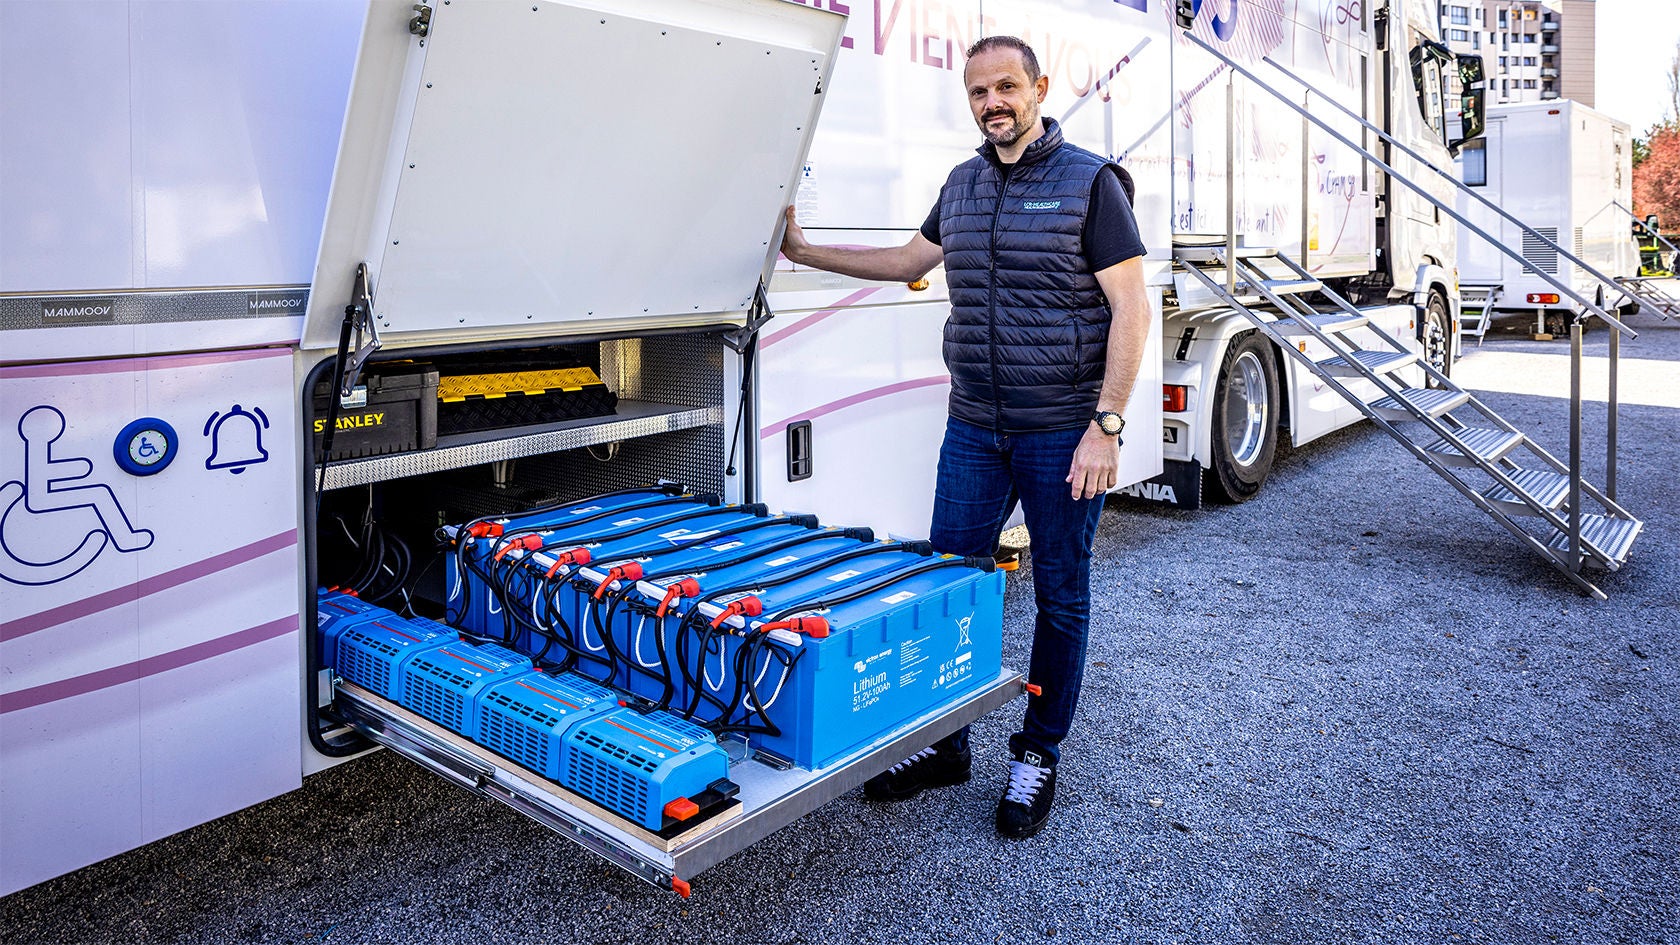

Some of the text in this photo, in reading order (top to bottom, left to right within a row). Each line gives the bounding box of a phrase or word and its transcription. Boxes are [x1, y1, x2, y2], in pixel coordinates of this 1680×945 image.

[44, 306, 111, 317] MAMMOOV
[250, 299, 302, 309] MAMMOOV
[313, 412, 385, 433] SANLEY
[1112, 481, 1178, 504] ANIA
[853, 671, 887, 695] Lithium
